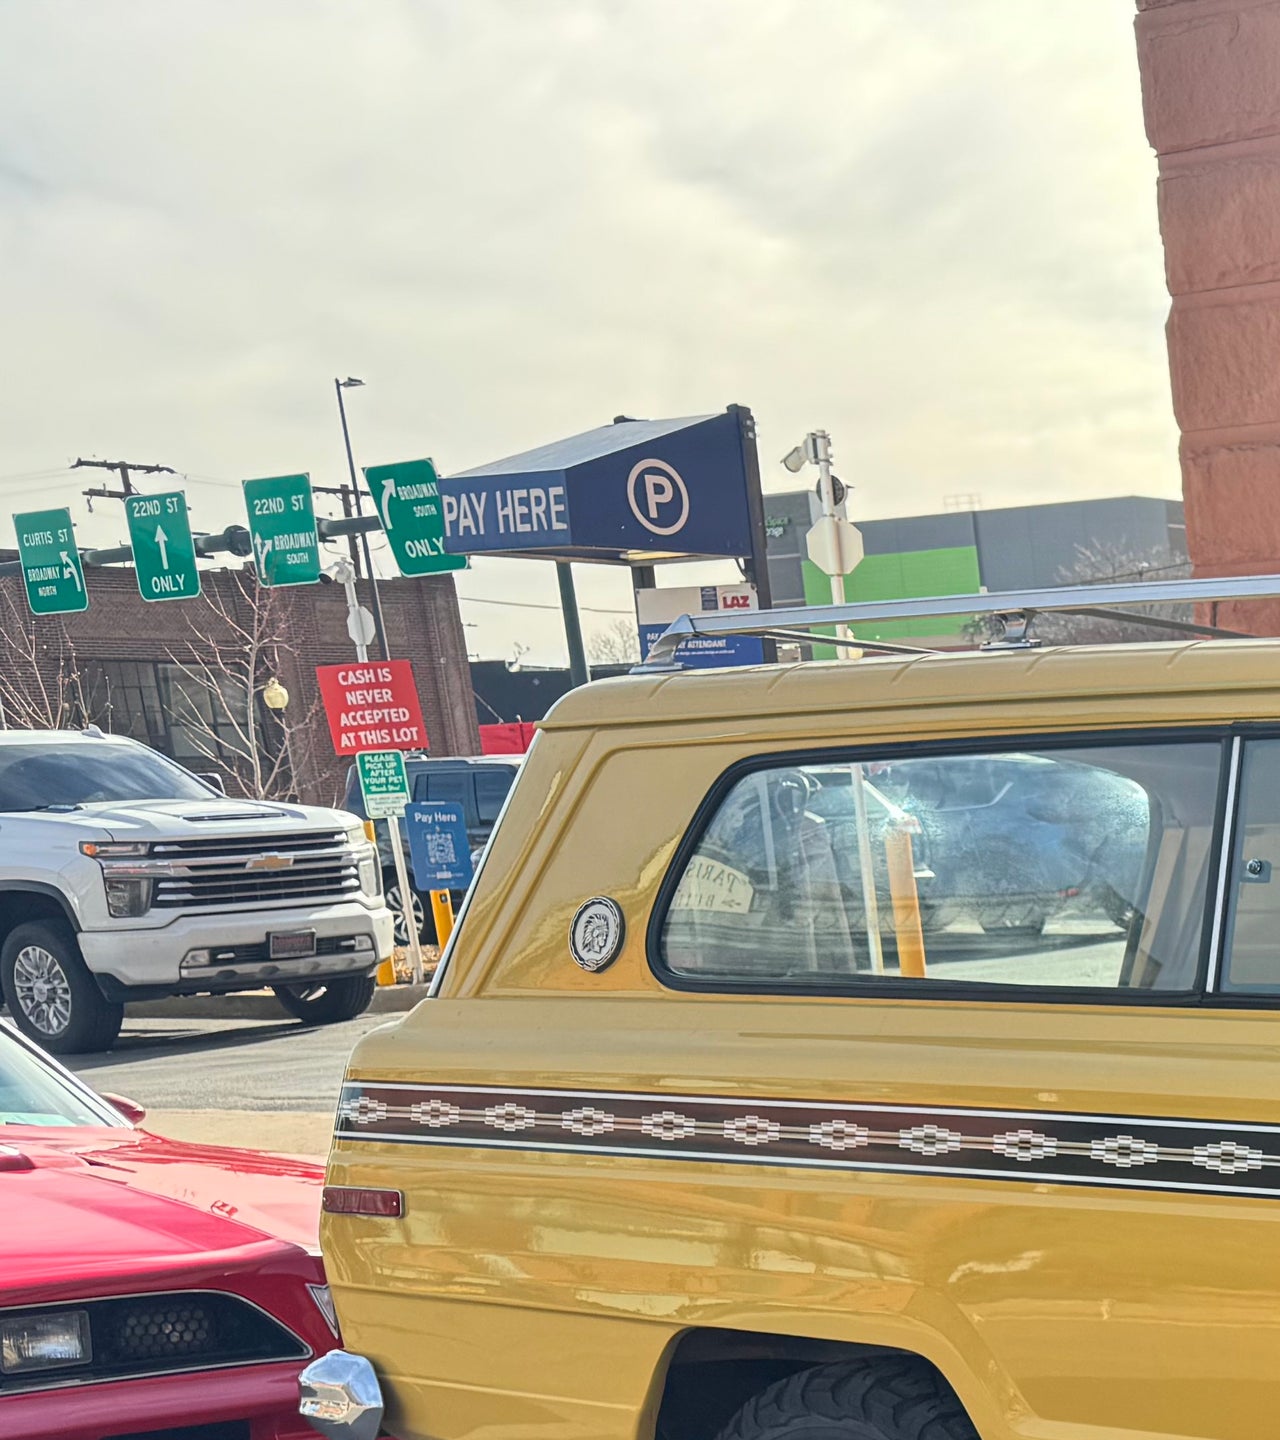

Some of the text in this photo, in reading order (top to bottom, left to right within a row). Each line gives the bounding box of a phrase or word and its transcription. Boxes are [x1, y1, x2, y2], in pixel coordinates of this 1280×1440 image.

[397, 481, 438, 500] BROADWAY
[644, 474, 673, 519] P
[132, 497, 180, 518] 22ND ST
[254, 495, 305, 515] 22ND ST
[413, 503, 437, 518] SOUTH
[442, 486, 568, 537] PAY HERE
[23, 529, 69, 547] CURTIS ST
[274, 531, 315, 551] BROADWAY
[405, 536, 445, 559] ONLY
[286, 552, 309, 565] SOUTH
[27, 565, 60, 582] BROADWAY
[38, 585, 57, 597] NORTH
[151, 574, 185, 593] ONLY
[722, 595, 750, 609] LAZ
[338, 668, 392, 686] CASH IS
[345, 689, 393, 706] NEVER
[340, 707, 410, 727] ACCEPTED
[341, 727, 418, 748] AT THIS LOT
[364, 753, 395, 763] PLEASE
[388, 775, 403, 783] PET
[414, 811, 457, 824] Pay Here
